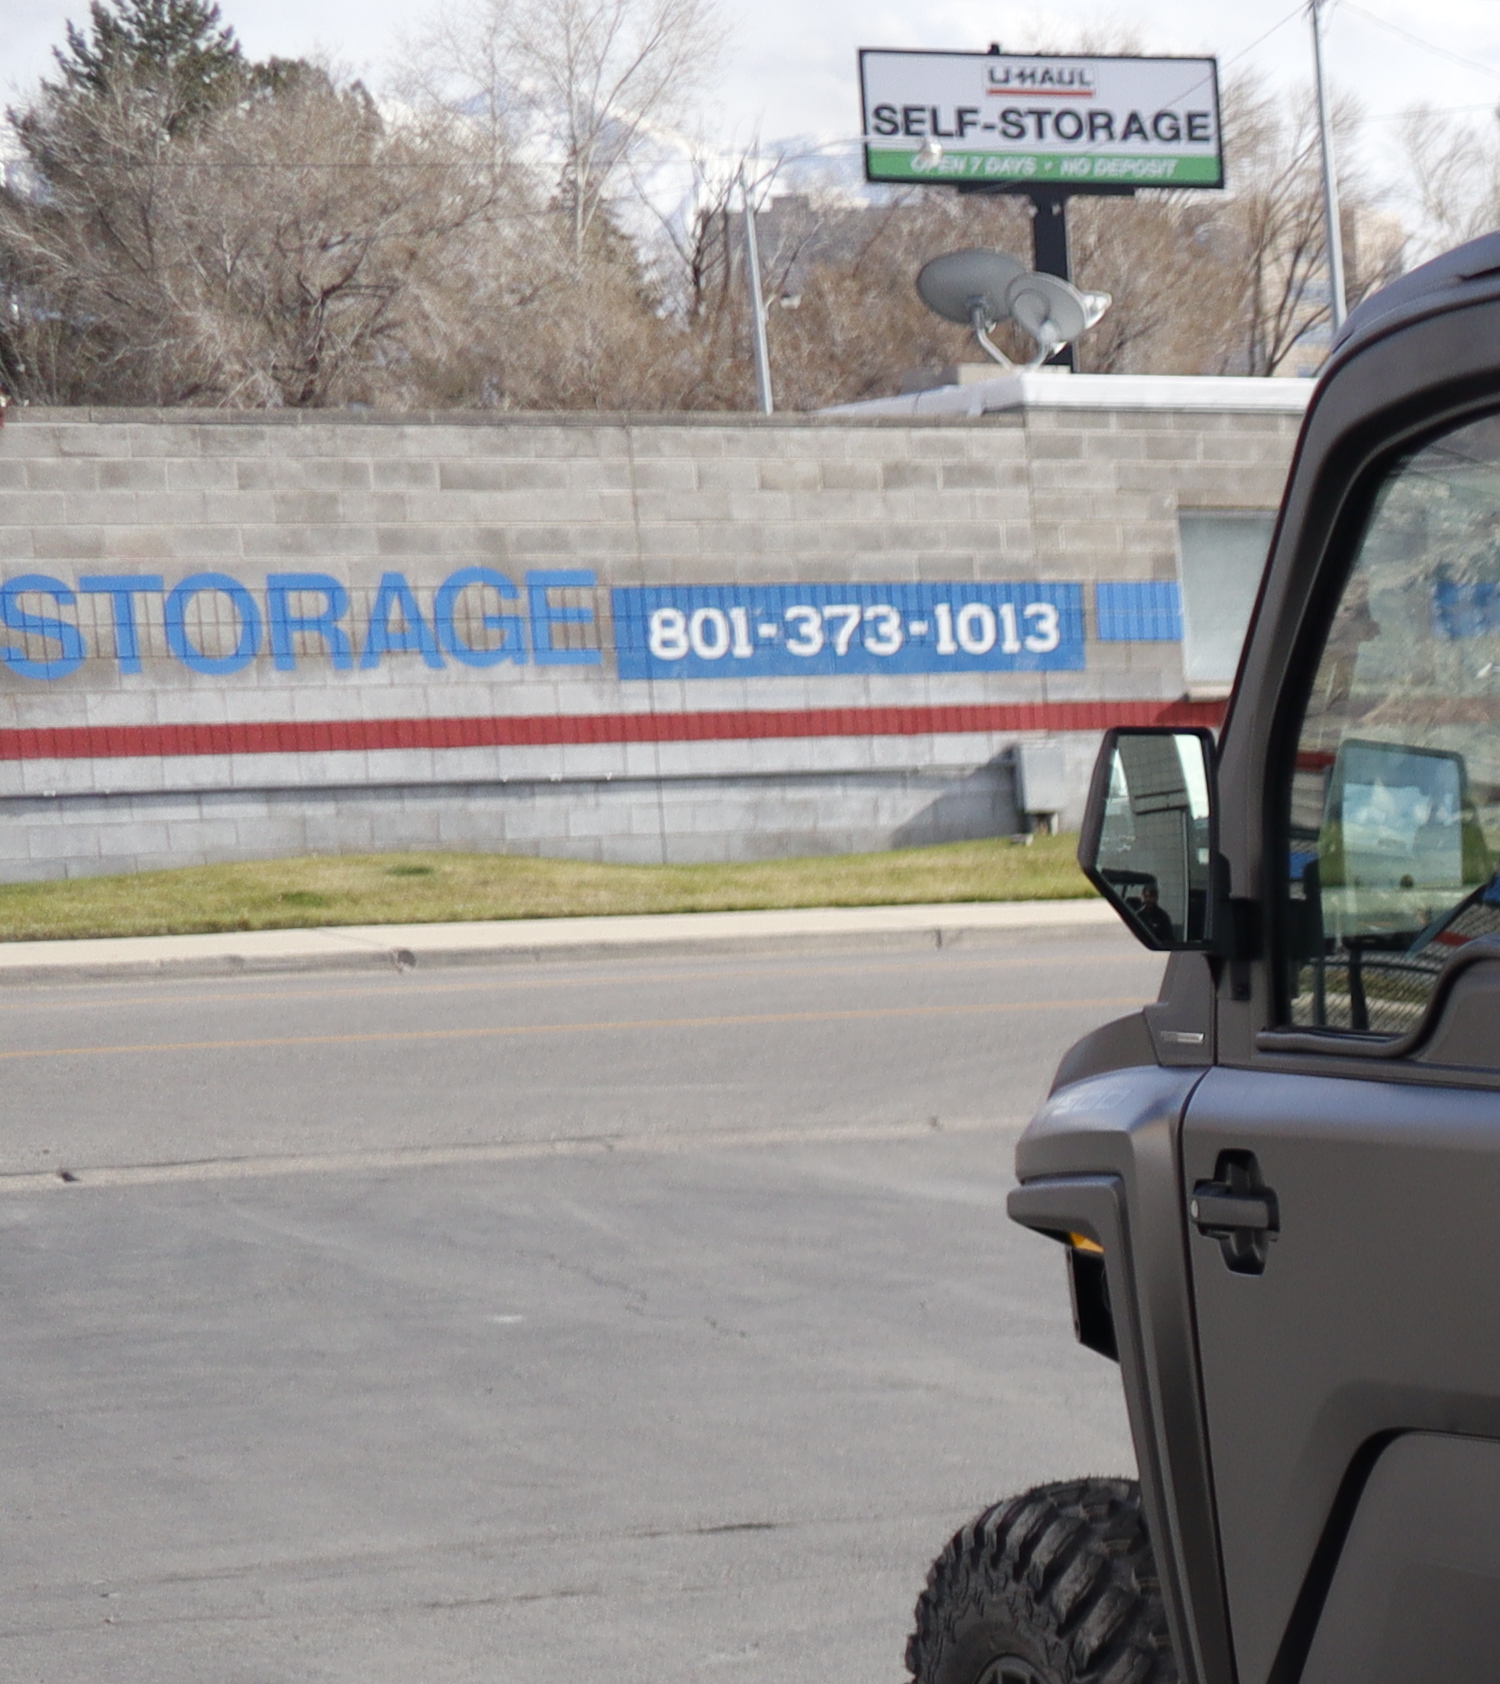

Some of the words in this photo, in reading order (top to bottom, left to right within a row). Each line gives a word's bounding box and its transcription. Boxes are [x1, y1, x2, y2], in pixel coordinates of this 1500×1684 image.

[987, 66, 1094, 87] U-HAUL
[872, 104, 1212, 143] SELF-STORAGE
[970, 155, 984, 175] 7
[985, 156, 1037, 176] DAYS
[1060, 157, 1091, 176] NO
[1093, 157, 1179, 178] DEPOSIT
[0, 565, 602, 681] STORAGE
[648, 602, 1061, 660] 801-373-1013
